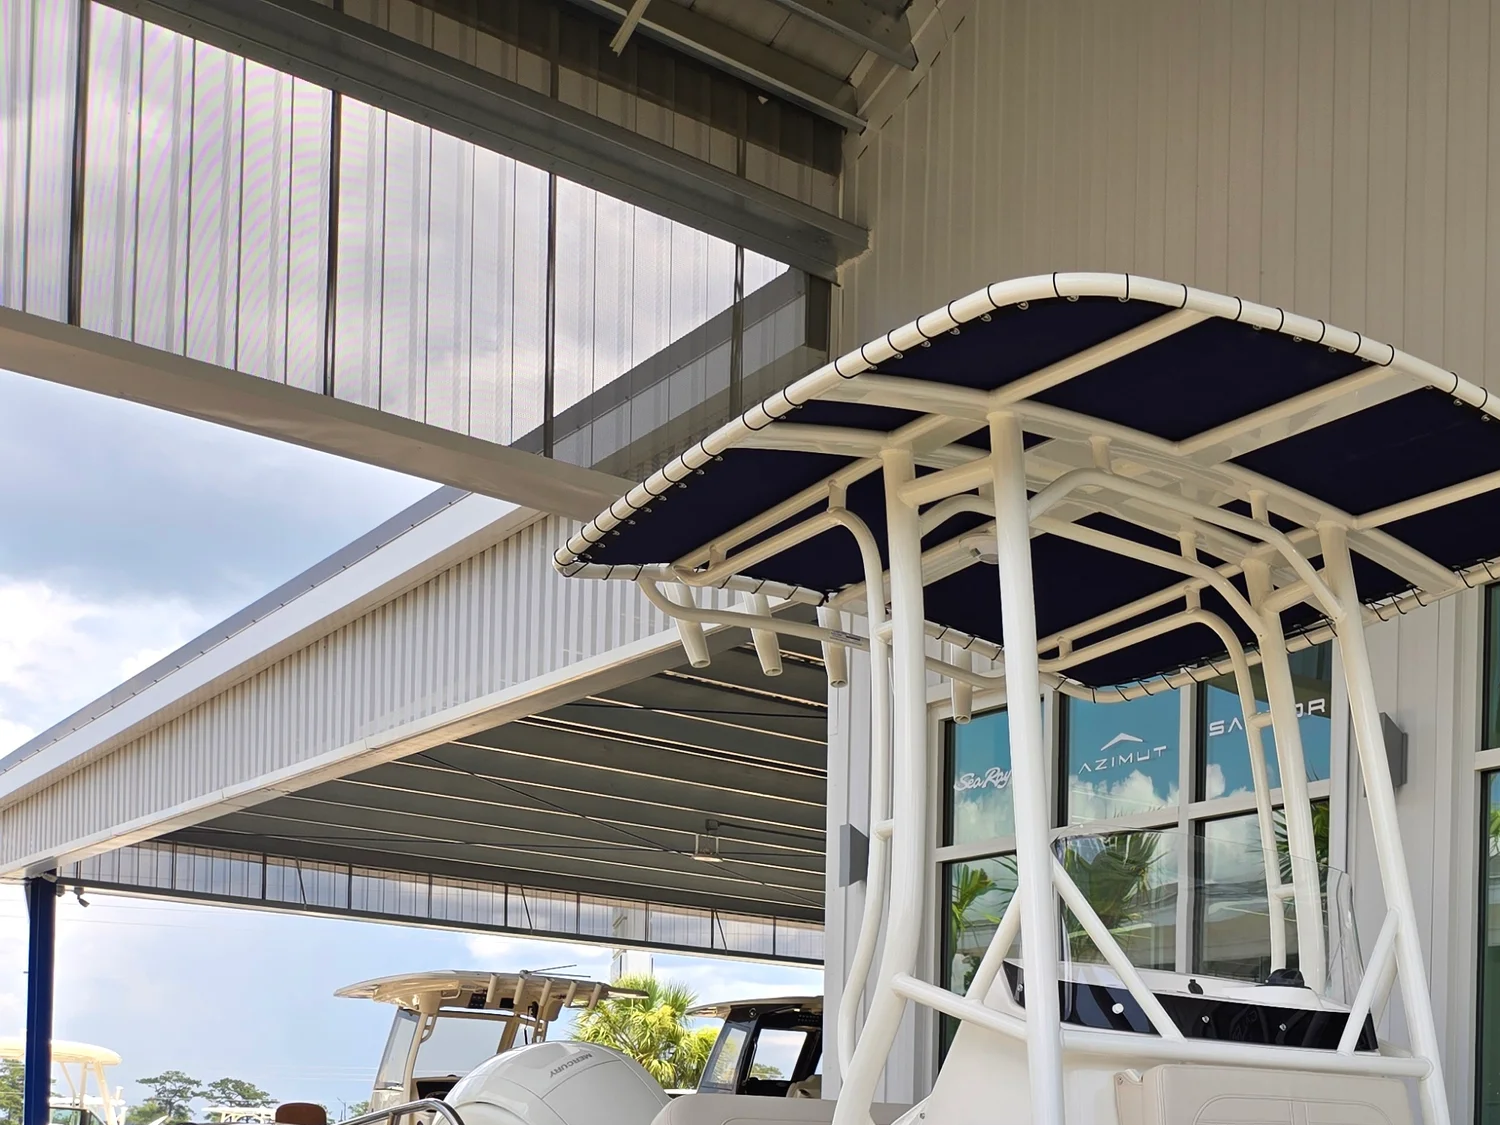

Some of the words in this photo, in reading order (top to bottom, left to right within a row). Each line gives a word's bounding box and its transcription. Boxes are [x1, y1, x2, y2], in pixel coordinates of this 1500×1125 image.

[1209, 698, 1325, 736] SAR
[1079, 746, 1167, 774] AZIMUT
[954, 773, 983, 791] Sea
[550, 1053, 593, 1078] MERCURY
